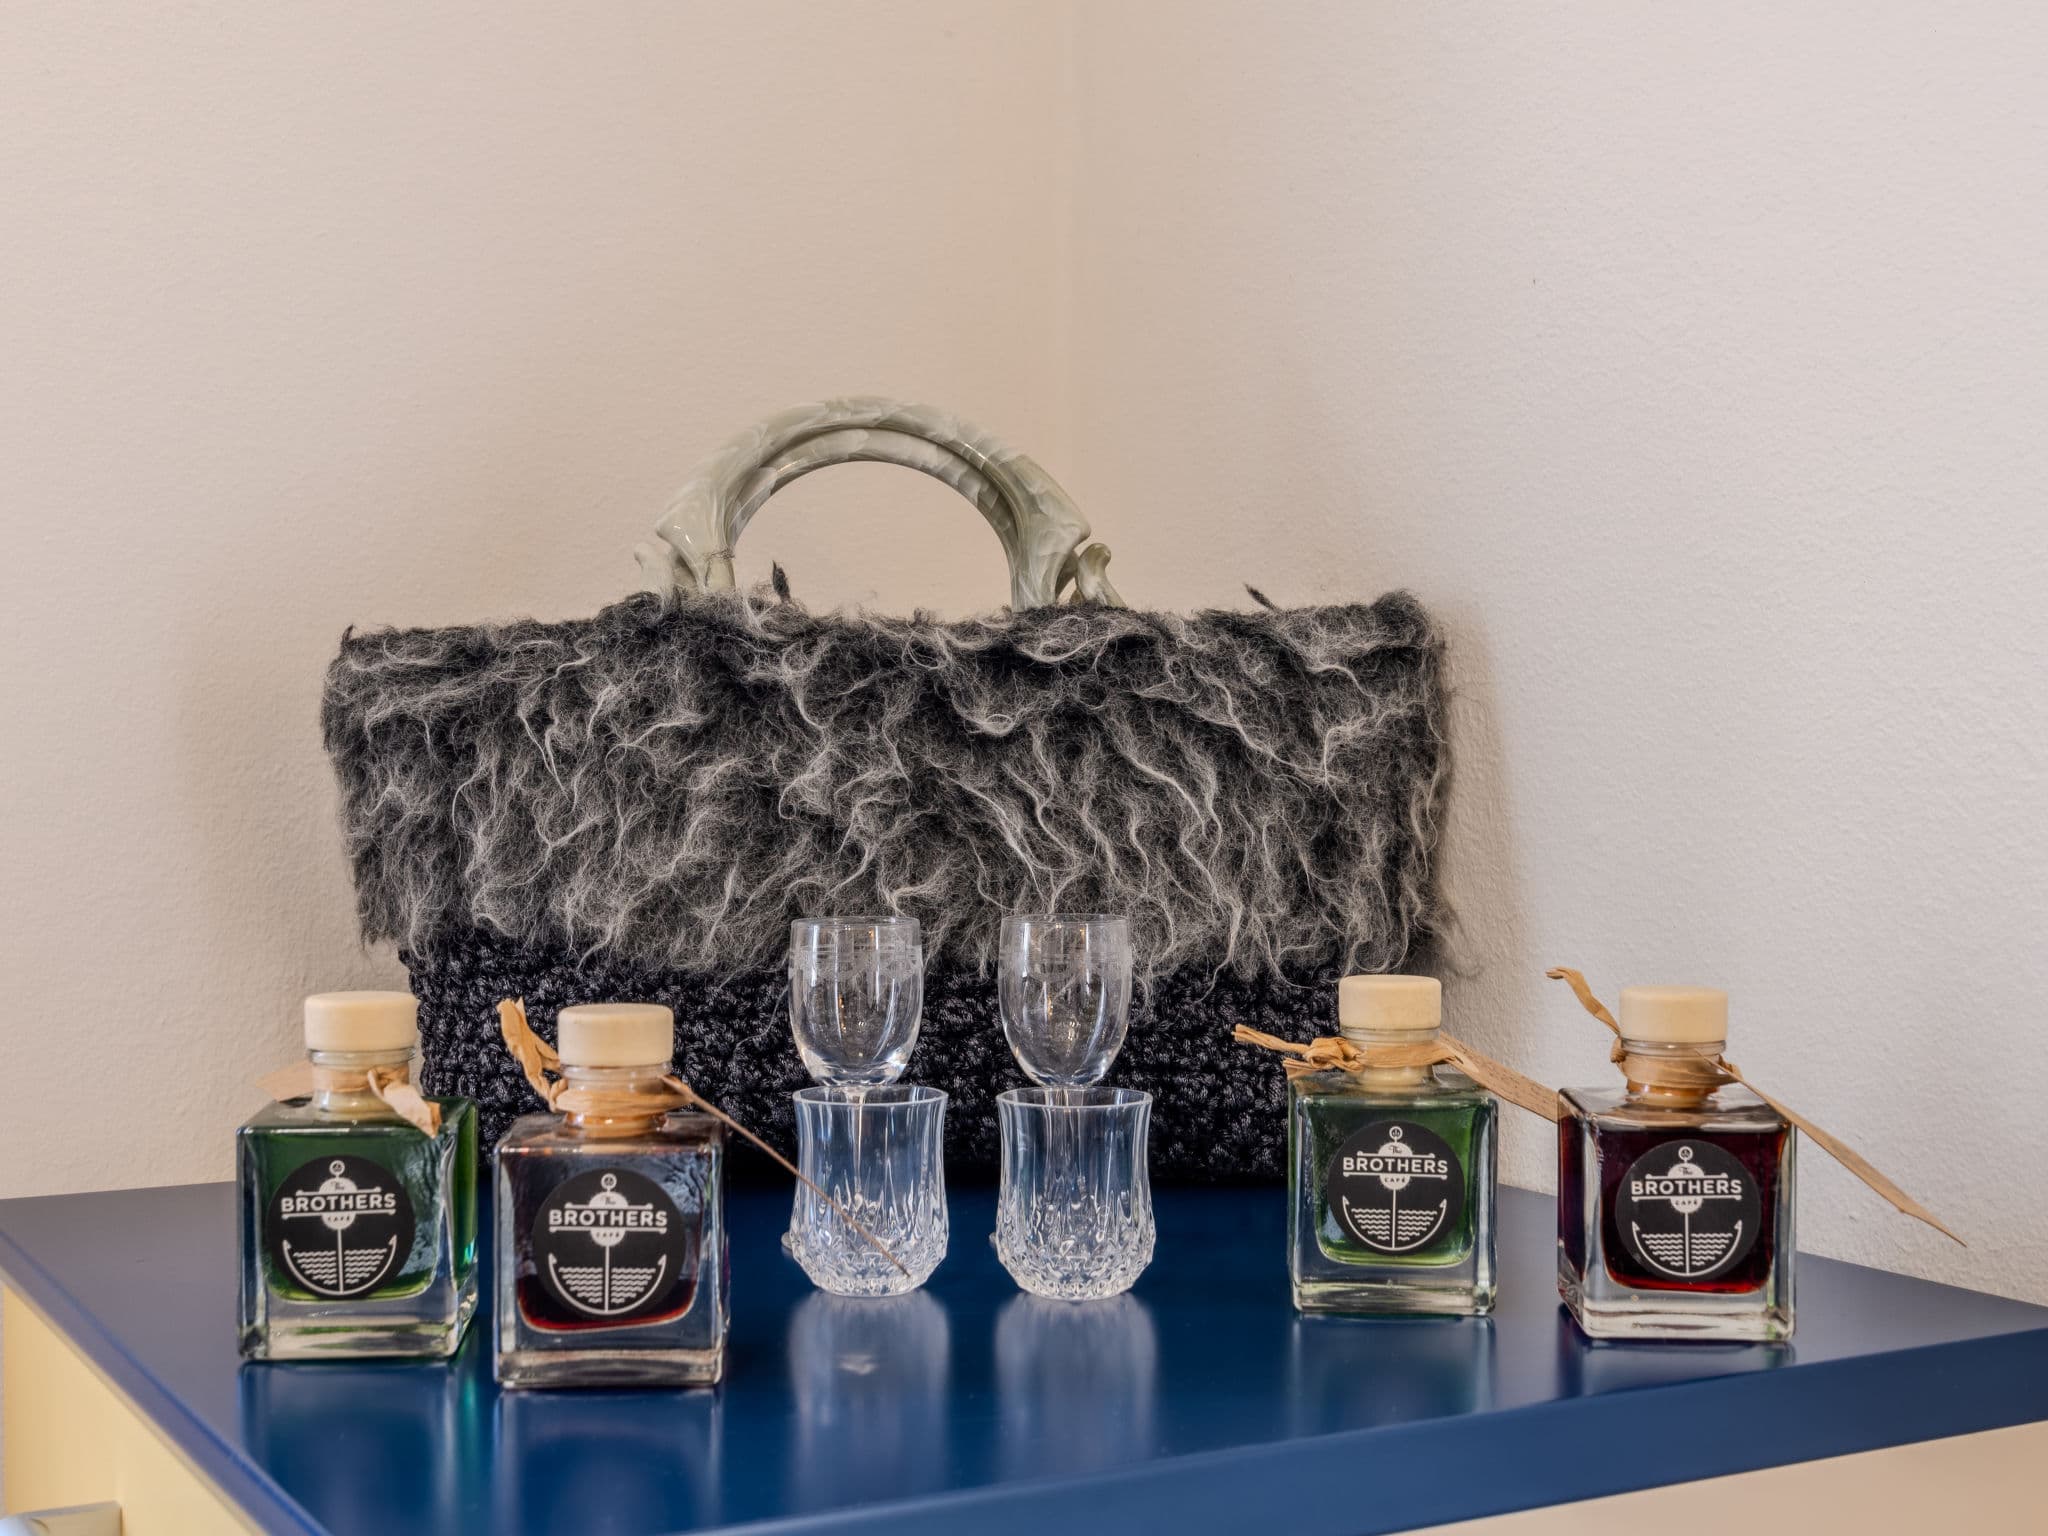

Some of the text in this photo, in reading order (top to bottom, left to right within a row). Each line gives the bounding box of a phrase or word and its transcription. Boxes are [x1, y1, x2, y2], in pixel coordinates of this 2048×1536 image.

[1388, 1144, 1403, 1155] The
[1342, 1157, 1448, 1173] BROTHERS
[1630, 1180, 1742, 1195] BROTHERS
[281, 1193, 396, 1212] BROTHERS
[549, 1209, 667, 1226] BROTHERS
